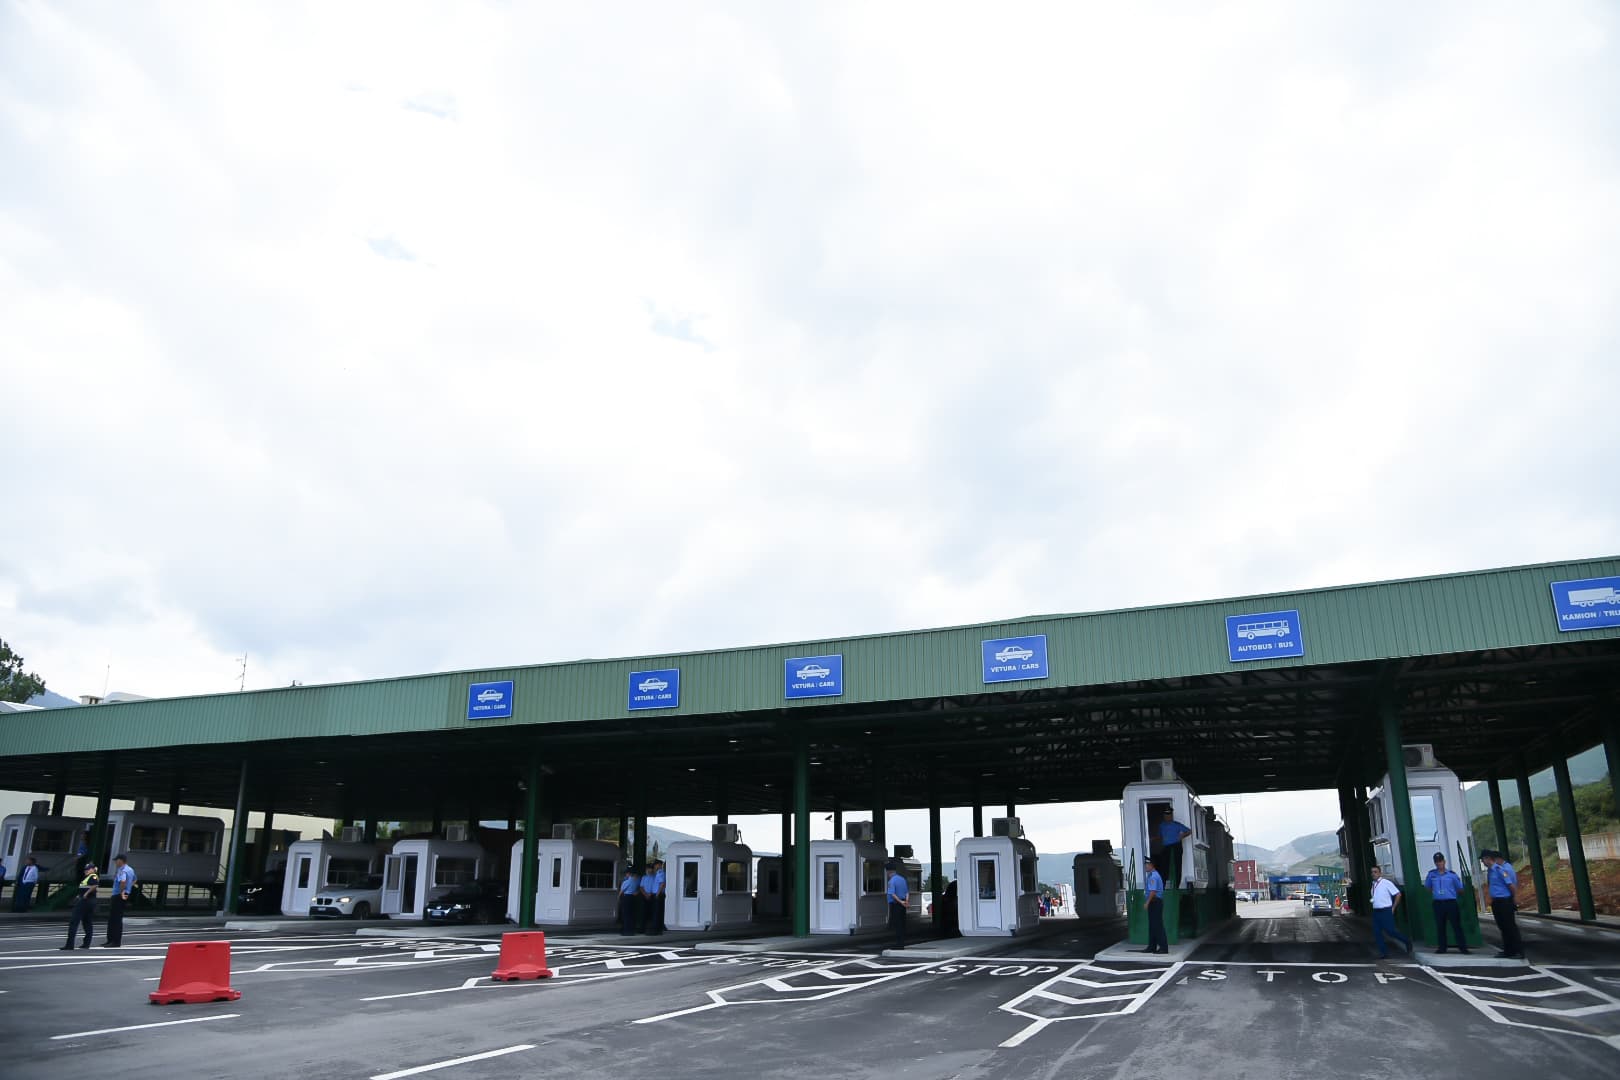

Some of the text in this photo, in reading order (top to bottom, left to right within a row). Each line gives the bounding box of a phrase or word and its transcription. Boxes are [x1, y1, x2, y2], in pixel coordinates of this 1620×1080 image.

[1562, 612, 1597, 620] KAMION
[1238, 643, 1272, 652] AUTOBUS
[1278, 641, 1294, 649] BUS
[990, 665, 1017, 673] VETURA
[926, 964, 1059, 977] STOP
[1196, 969, 1407, 984] STOP
